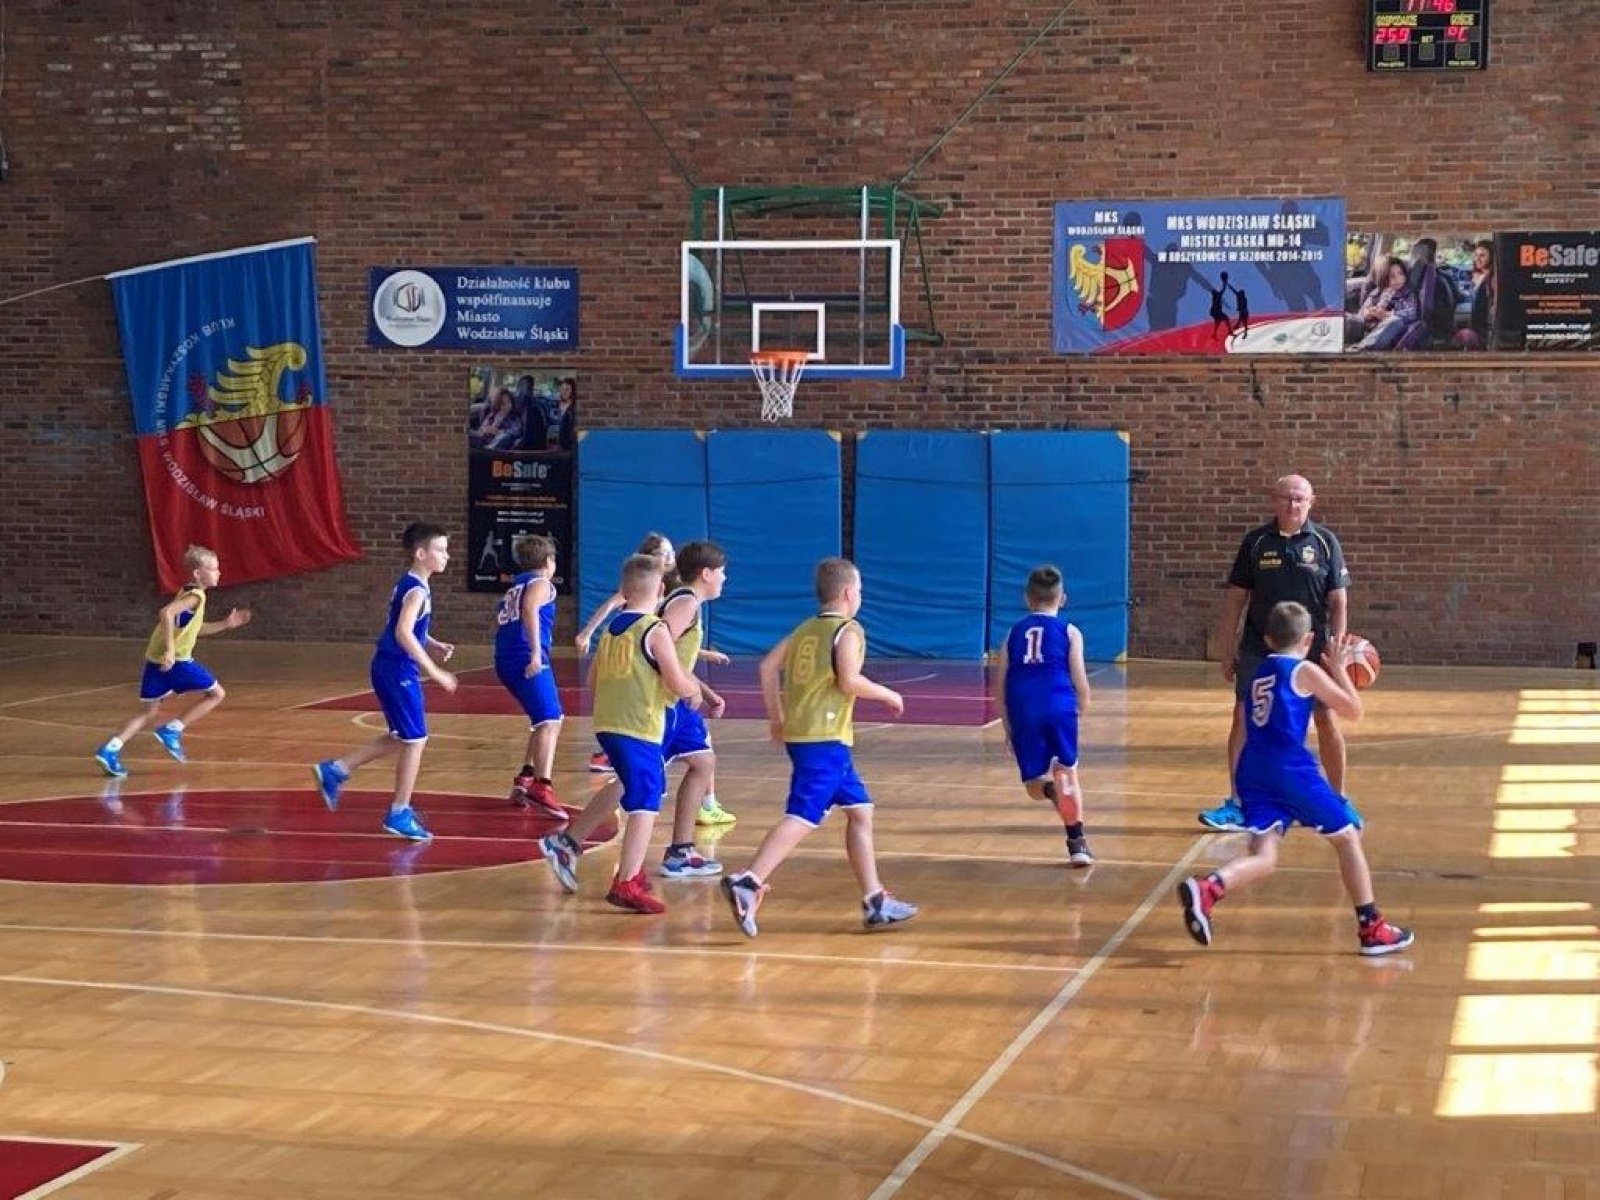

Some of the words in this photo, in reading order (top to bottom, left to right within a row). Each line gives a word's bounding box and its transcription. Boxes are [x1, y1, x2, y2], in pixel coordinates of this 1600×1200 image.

[1094, 211, 1118, 223] MKS
[1166, 215, 1193, 230] MKS
[1196, 214, 1270, 230] WODZISŁAW
[1273, 213, 1316, 231] ŚLĄSKI
[1181, 235, 1220, 247] MISTRZ
[1158, 252, 1167, 262] W
[1168, 251, 1226, 262] KOSZYKÓWCE
[1228, 251, 1237, 261] W
[1239, 251, 1274, 261] SEZONIE
[1276, 251, 1323, 261] 2014-2015
[1520, 244, 1598, 267] BeSafe
[457, 276, 530, 290] Działalność
[534, 276, 571, 289] klubu
[456, 293, 552, 309] współfinansuje
[457, 311, 500, 323] Miasto
[457, 327, 526, 340] Wodzisław
[530, 325, 569, 342] Śląski
[202, 316, 235, 337] KLUB
[219, 502, 265, 519] ŚLĄSKI
[492, 460, 548, 479] BeSafe
[1023, 626, 1044, 665] 1
[1252, 674, 1276, 727] 5
